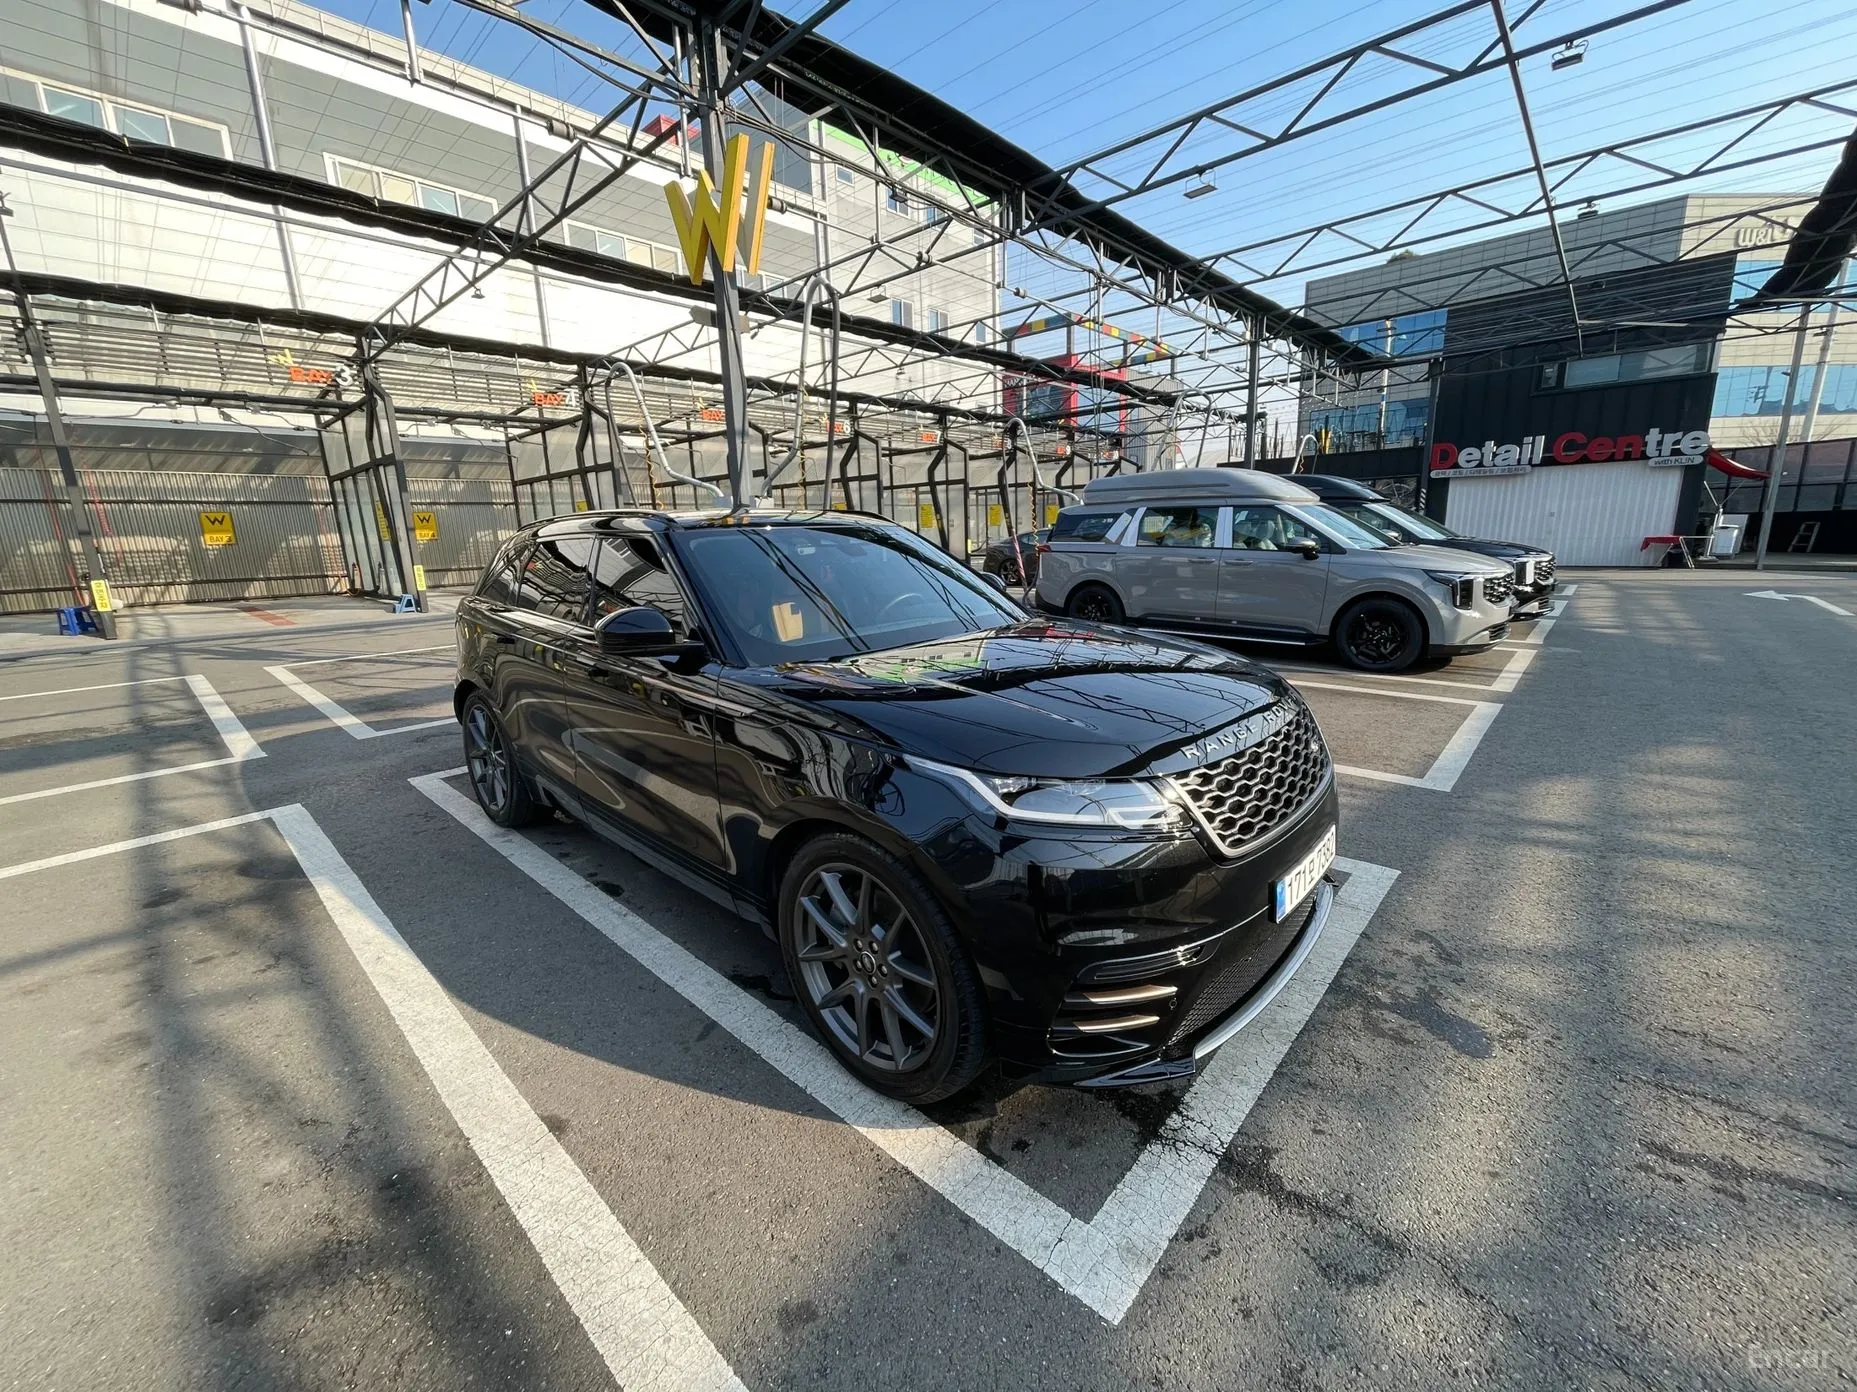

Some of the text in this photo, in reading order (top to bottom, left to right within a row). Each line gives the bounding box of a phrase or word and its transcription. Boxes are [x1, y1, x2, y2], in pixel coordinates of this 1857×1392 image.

[288, 363, 354, 386] BAY 3
[534, 392, 563, 406] BAY
[843, 418, 851, 434] 6
[1430, 427, 1710, 470] Detail Centre
[204, 514, 226, 526] W
[416, 514, 432, 525] W
[209, 535, 234, 543] BAY 3
[1180, 721, 1258, 759] RANGE
[1287, 859, 1316, 905] 171모
